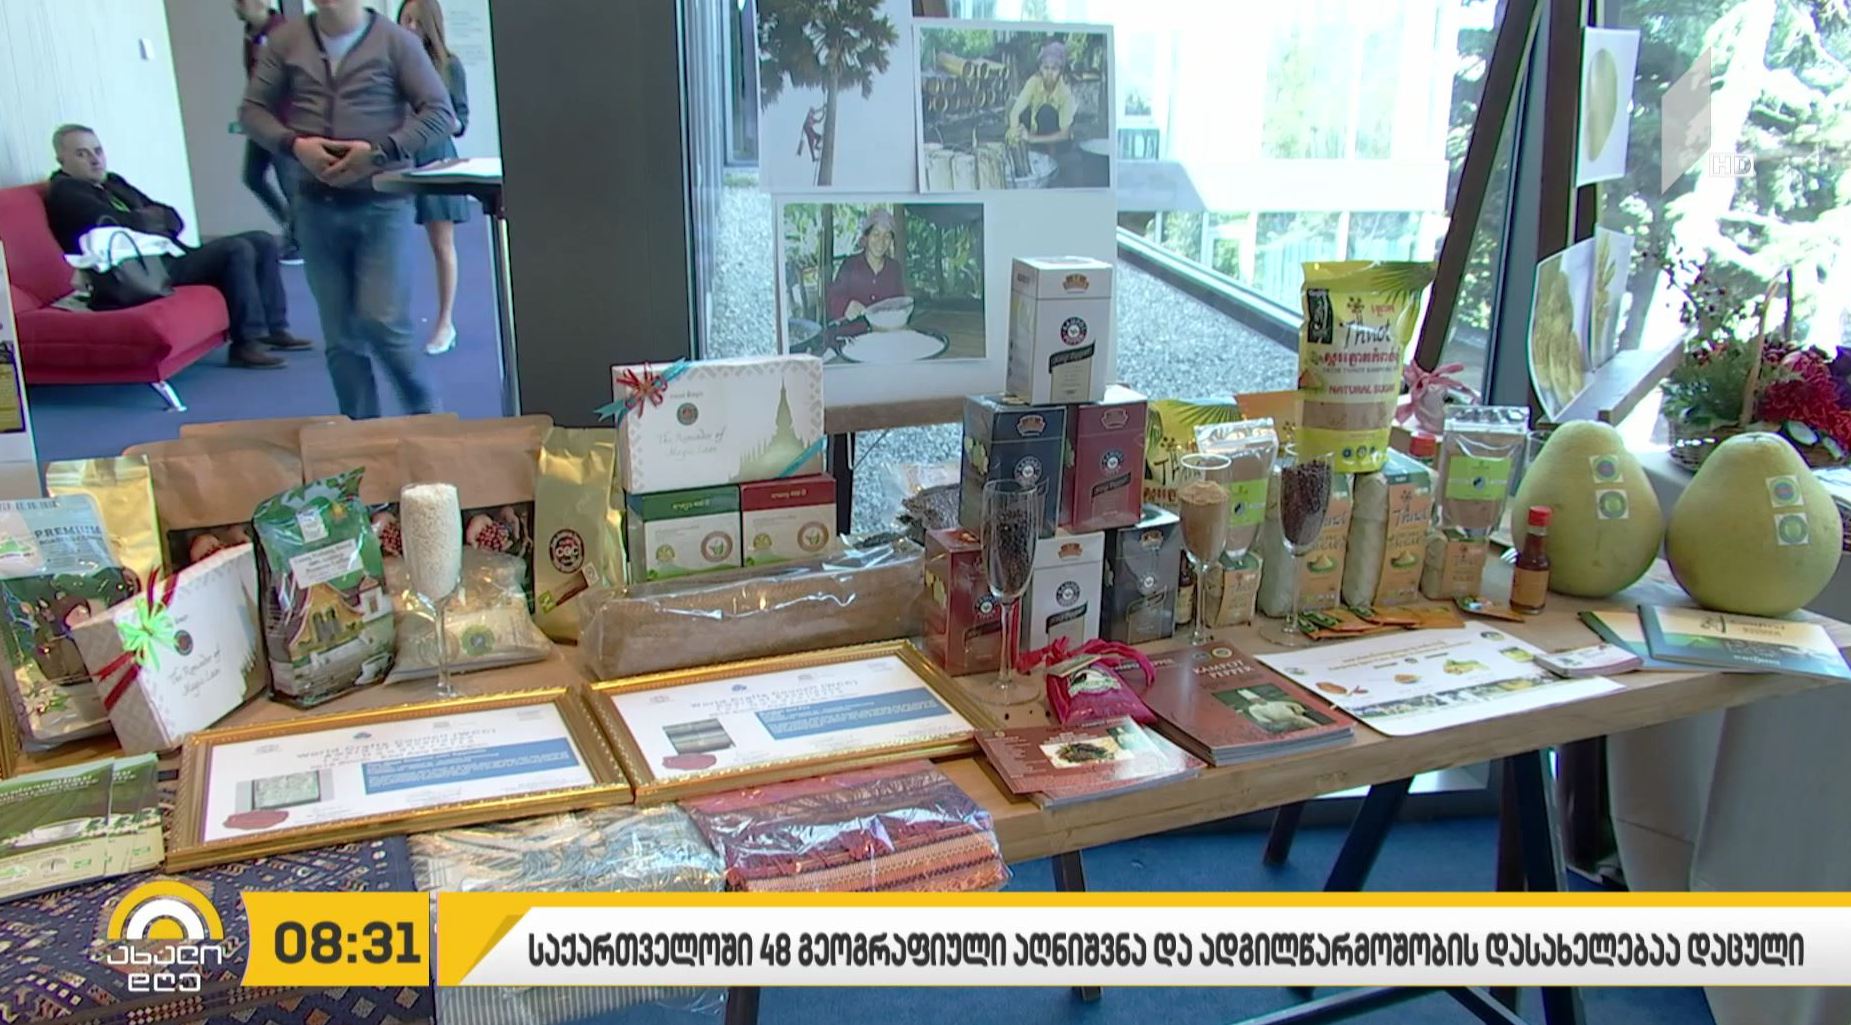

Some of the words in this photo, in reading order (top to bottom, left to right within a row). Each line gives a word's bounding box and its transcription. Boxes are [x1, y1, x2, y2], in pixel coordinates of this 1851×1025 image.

[1329, 385, 1372, 395] NATURAL
[34, 525, 102, 538] PREMIUM
[1193, 660, 1245, 674] KAMPOT
[1208, 666, 1254, 680] PEPPER
